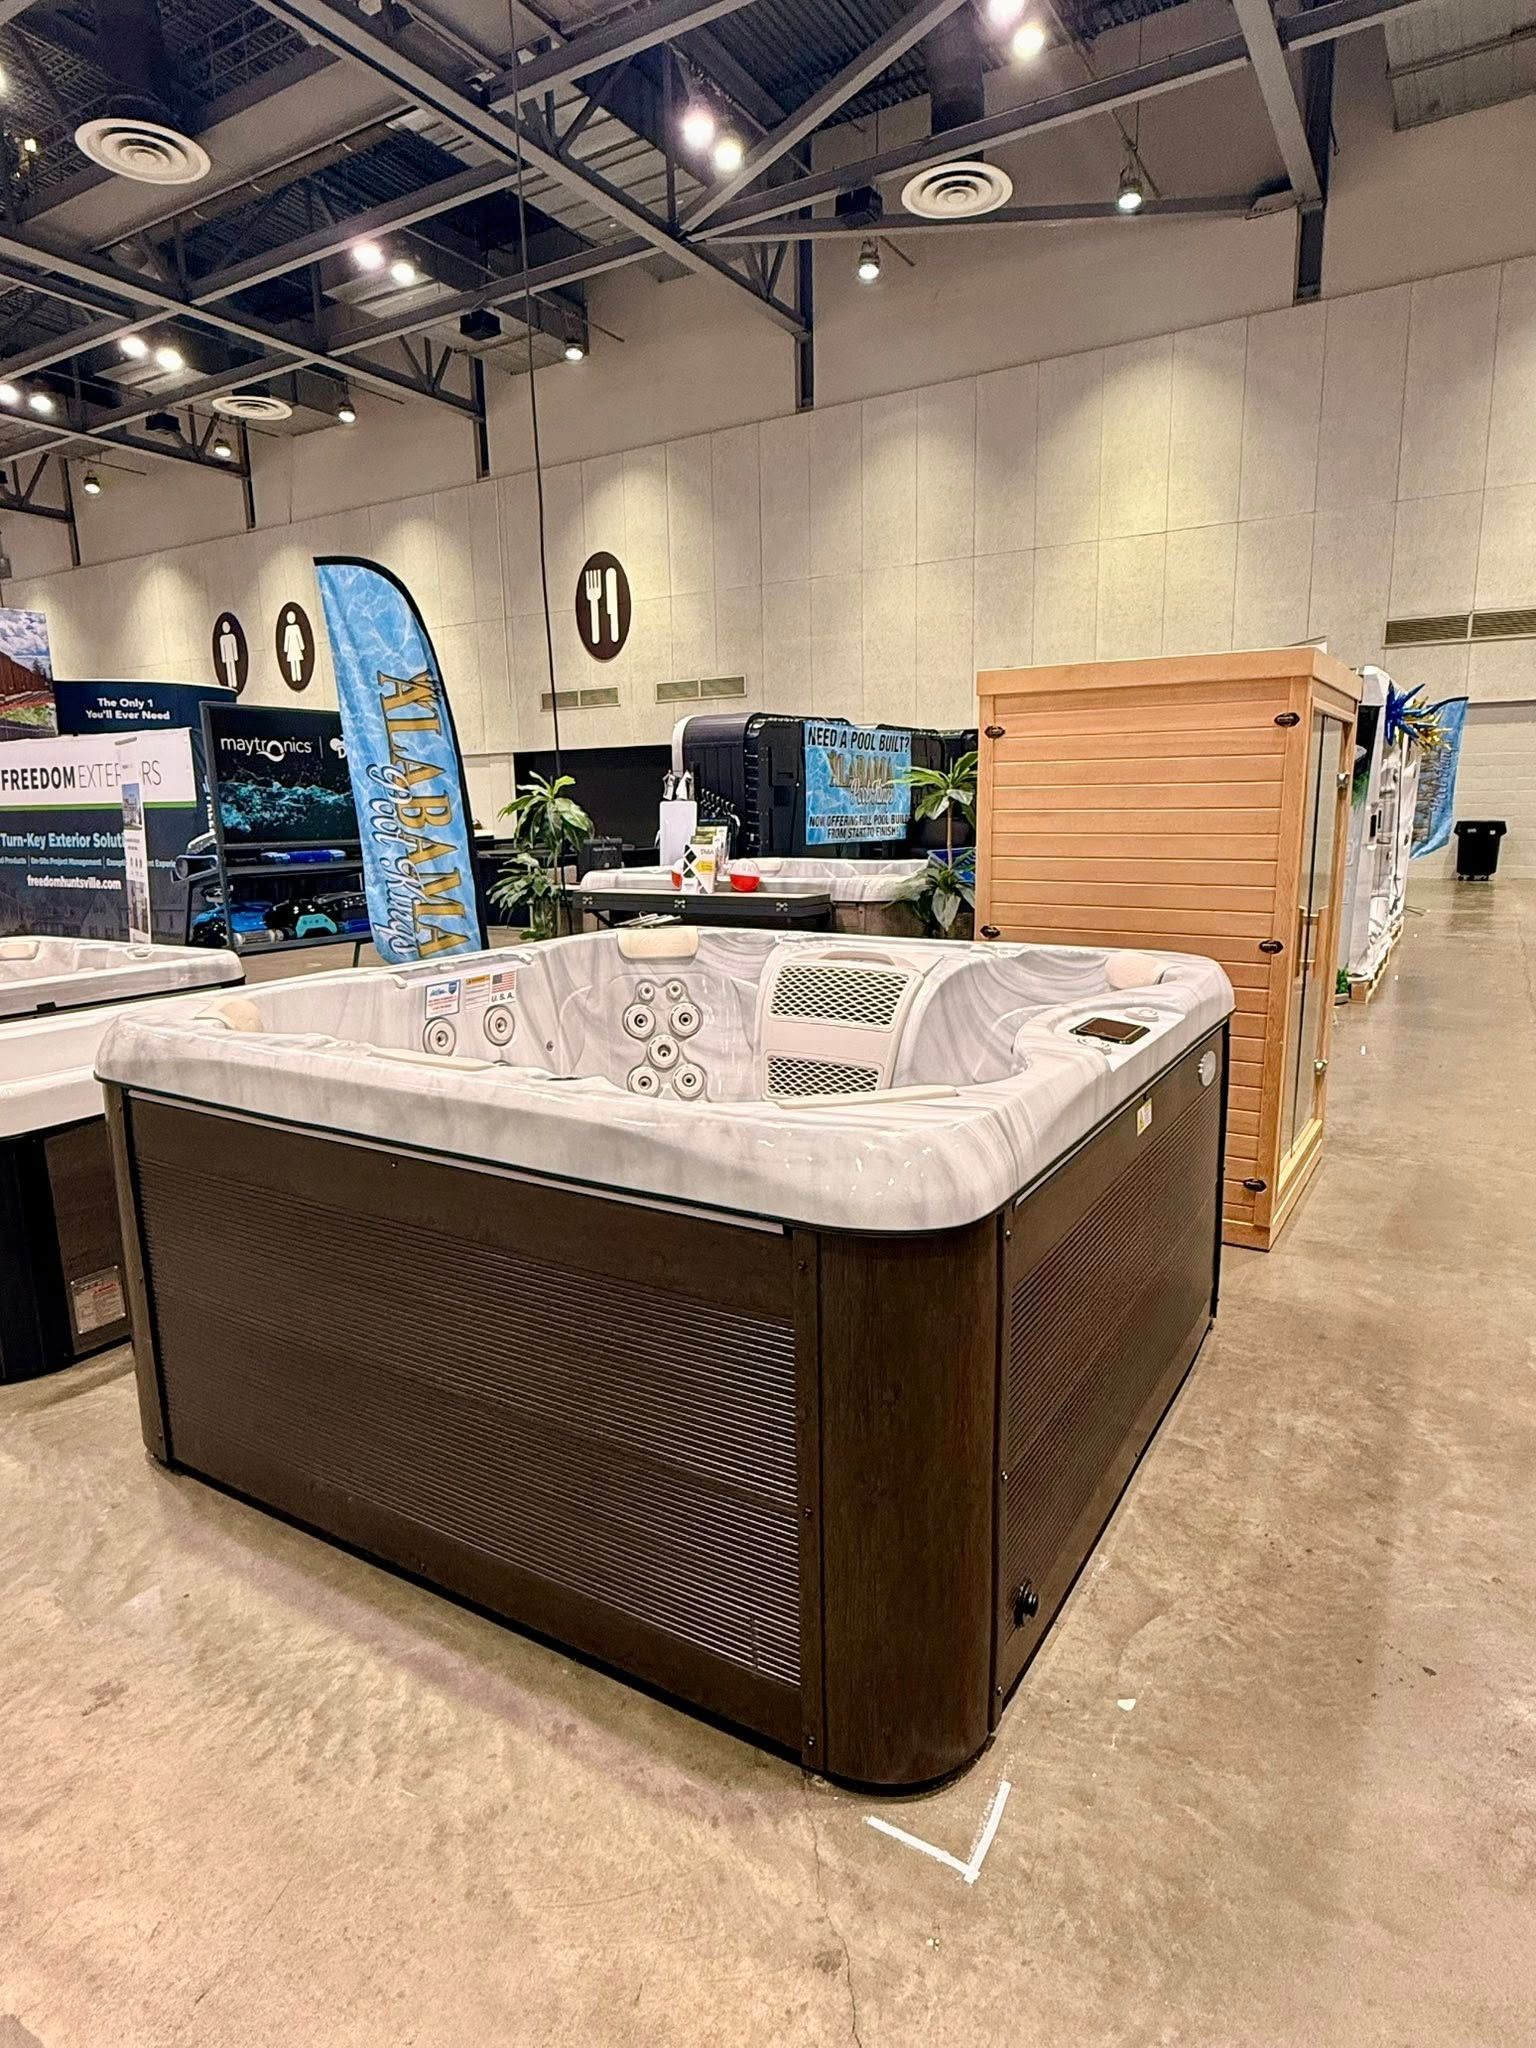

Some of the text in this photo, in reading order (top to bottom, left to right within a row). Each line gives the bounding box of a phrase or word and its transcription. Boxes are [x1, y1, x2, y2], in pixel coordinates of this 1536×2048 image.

[85, 709, 170, 720] You'll Ever Need
[97, 697, 154, 709] The Only 1
[220, 737, 312, 762] maytronics
[808, 726, 910, 753] NEED A POOL BUILT?
[1, 766, 75, 791] FREEDOM
[377, 669, 471, 958] ALABAMA
[0, 832, 46, 850] Turn-Key
[48, 832, 91, 848] Exterior
[93, 832, 125, 848] Soluti
[366, 763, 429, 963] Pool Kings
[27, 874, 122, 890] freedomhuntsville.com
